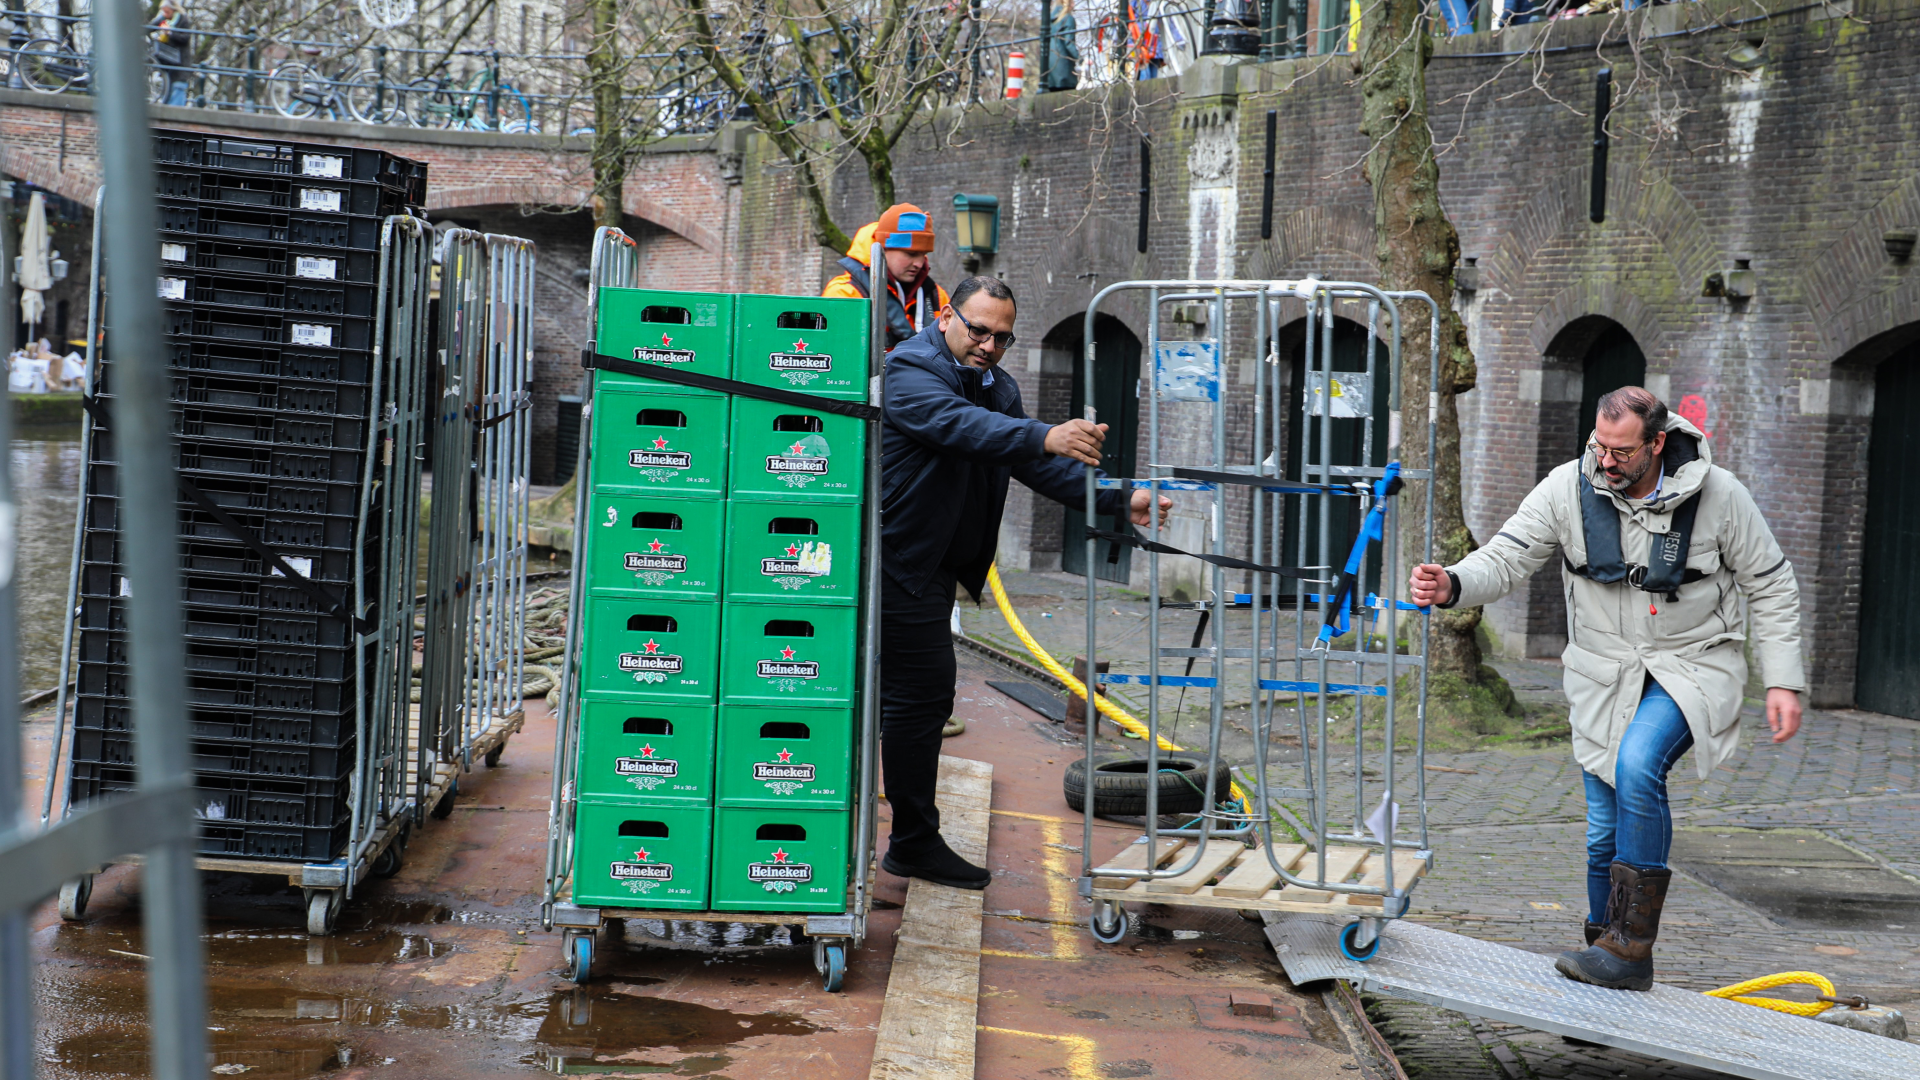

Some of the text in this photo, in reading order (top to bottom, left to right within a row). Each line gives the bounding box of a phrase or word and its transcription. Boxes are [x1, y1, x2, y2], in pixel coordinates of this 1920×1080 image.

[637, 351, 691, 362] Heineken
[773, 356, 827, 368] Heineken
[634, 454, 687, 466] Heineken
[771, 459, 824, 471] Heineken
[1663, 531, 1681, 561] BESTO
[629, 556, 682, 568] Heineken
[765, 562, 804, 573] Heine
[622, 656, 679, 669] Heineken
[761, 664, 815, 675] Heineken
[620, 761, 674, 774] Heineken
[758, 765, 811, 776] Heineken
[615, 865, 669, 877] Heineken
[751, 866, 808, 877] Heineken
